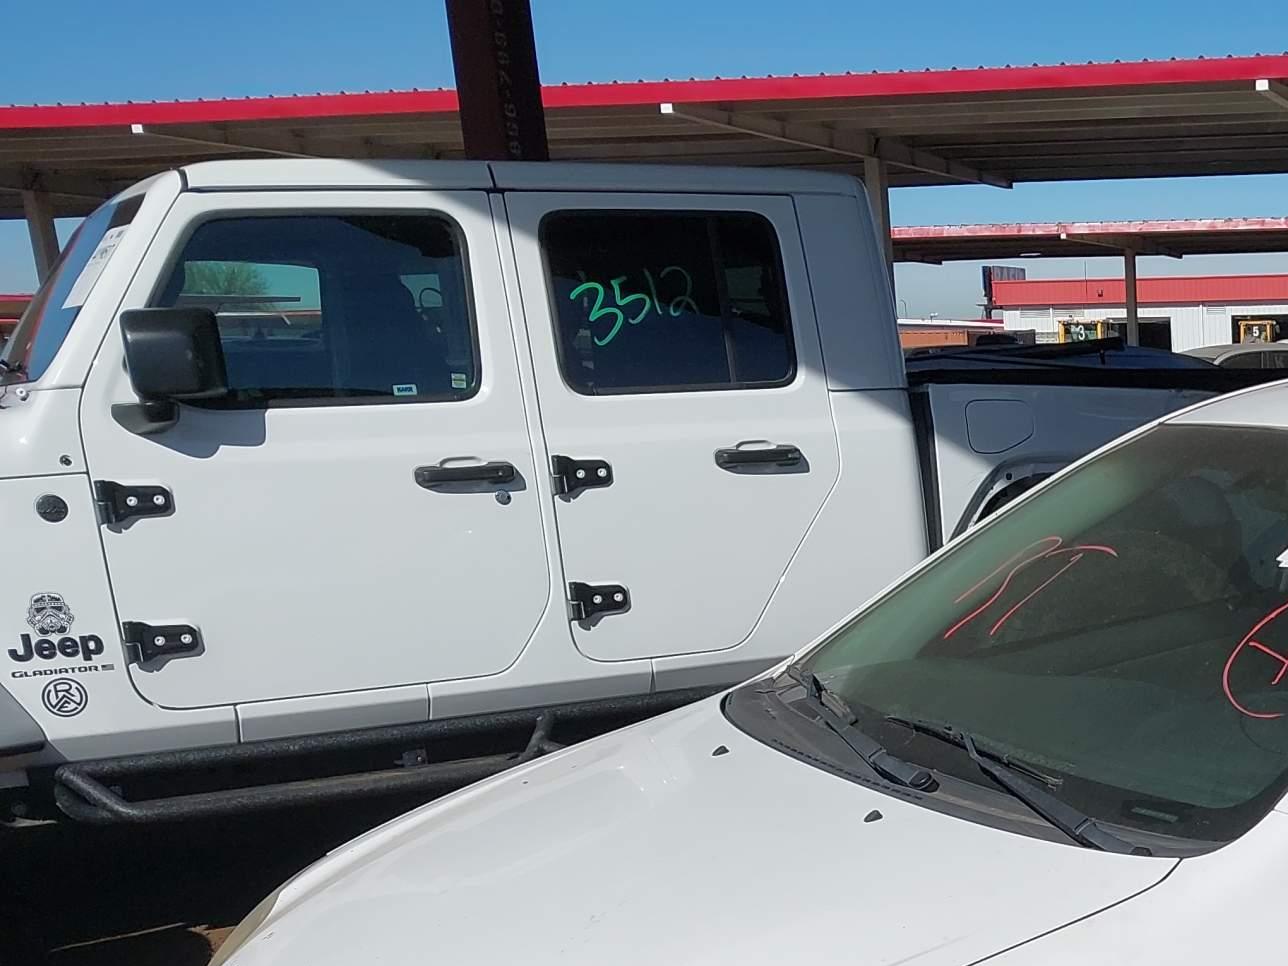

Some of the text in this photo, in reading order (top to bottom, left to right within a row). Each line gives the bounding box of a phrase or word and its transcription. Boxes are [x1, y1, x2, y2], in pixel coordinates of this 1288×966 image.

[569, 265, 699, 346] 3512
[1252, 326, 1260, 337] 5
[7, 633, 105, 663] Jeep
[11, 664, 99, 679] GLADIATOR
